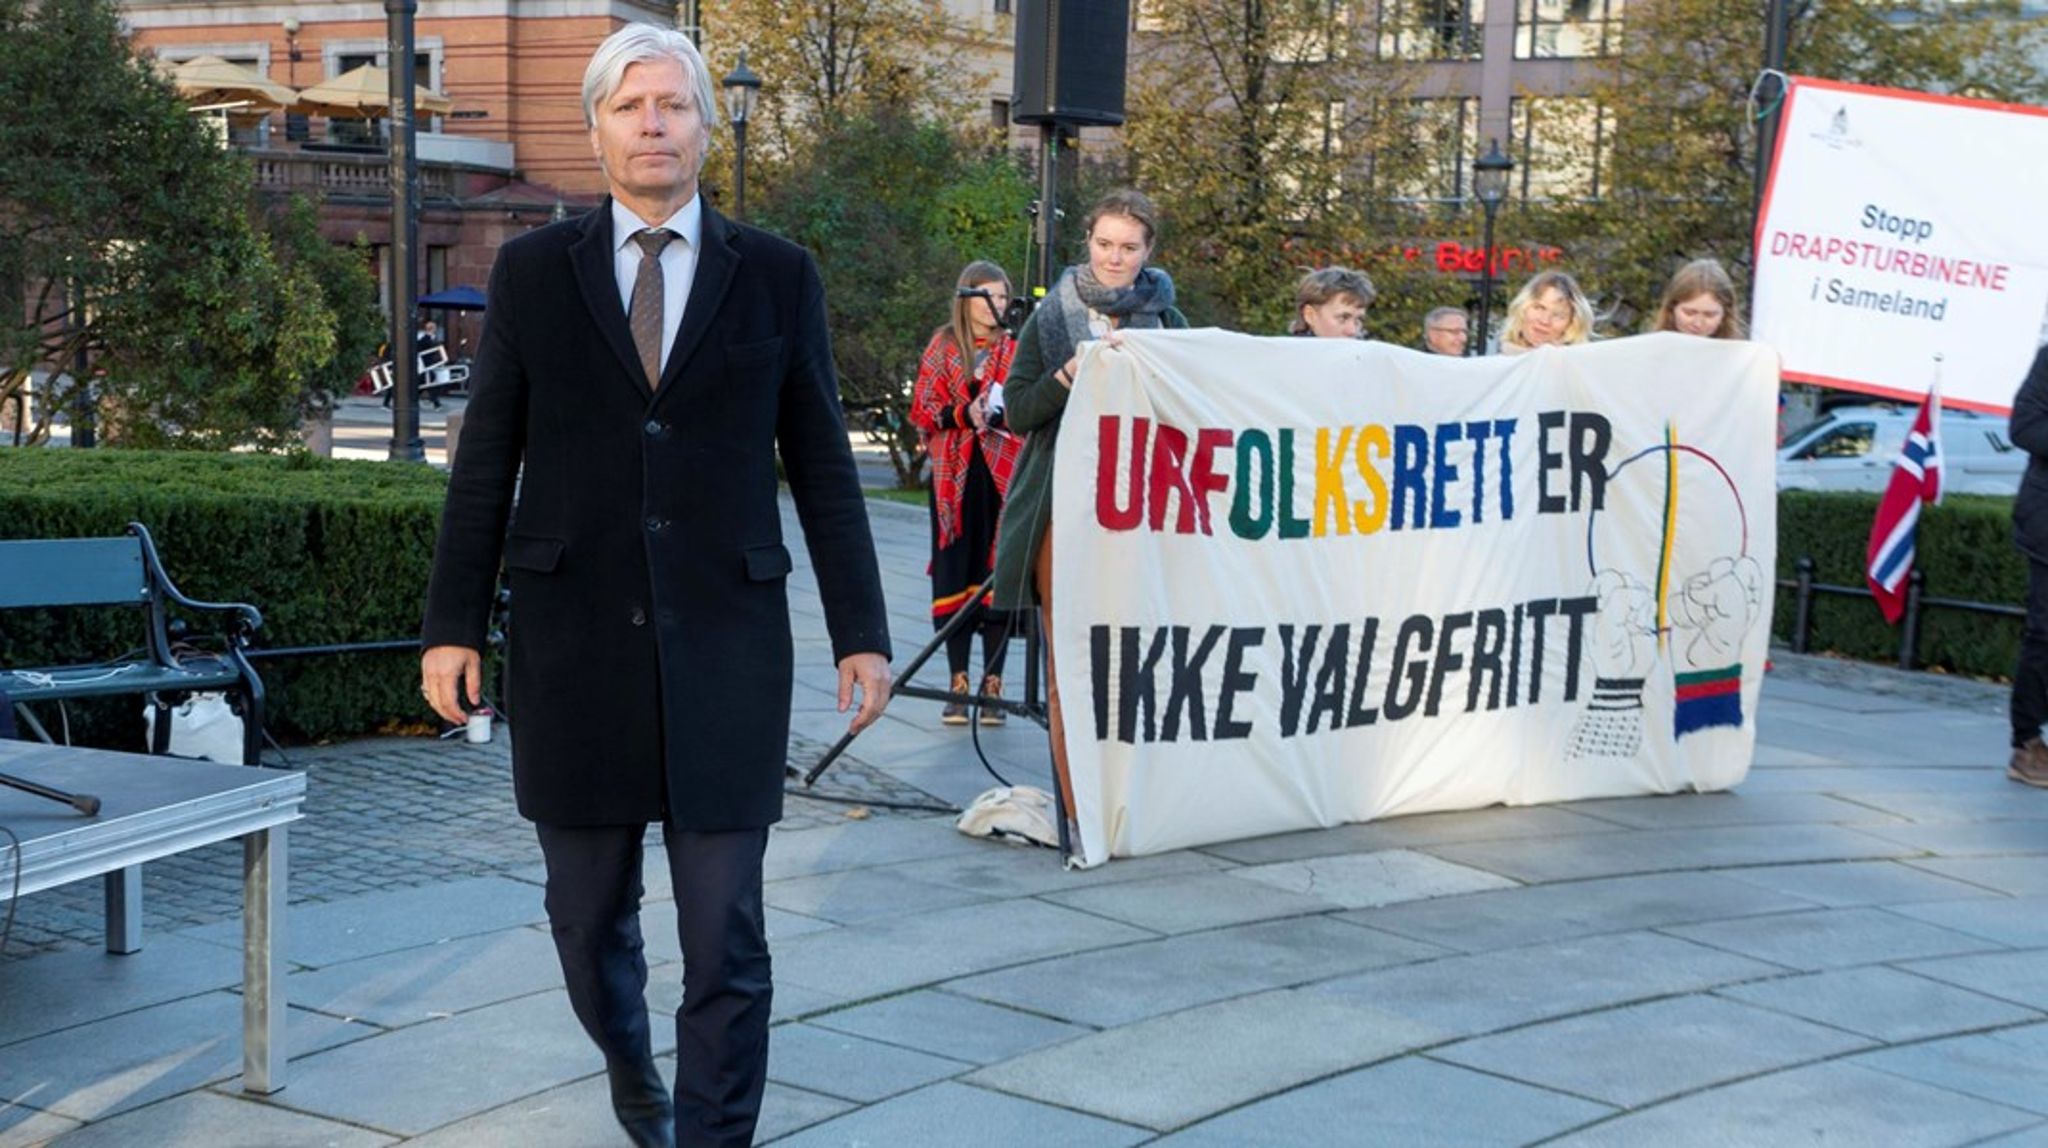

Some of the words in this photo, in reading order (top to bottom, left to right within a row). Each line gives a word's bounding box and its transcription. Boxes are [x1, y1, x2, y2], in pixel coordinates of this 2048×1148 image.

[1861, 204, 1932, 242] Stopp
[1771, 231, 2009, 291] DRAPSTURBINENE
[1811, 277, 1821, 300] i
[1825, 279, 1947, 321] Sameland
[1096, 414, 1518, 540] URFOLKSRETT
[1537, 410, 1612, 513] ER
[1090, 624, 1263, 743] IKKE
[1280, 597, 1597, 738] VALGFRITT
